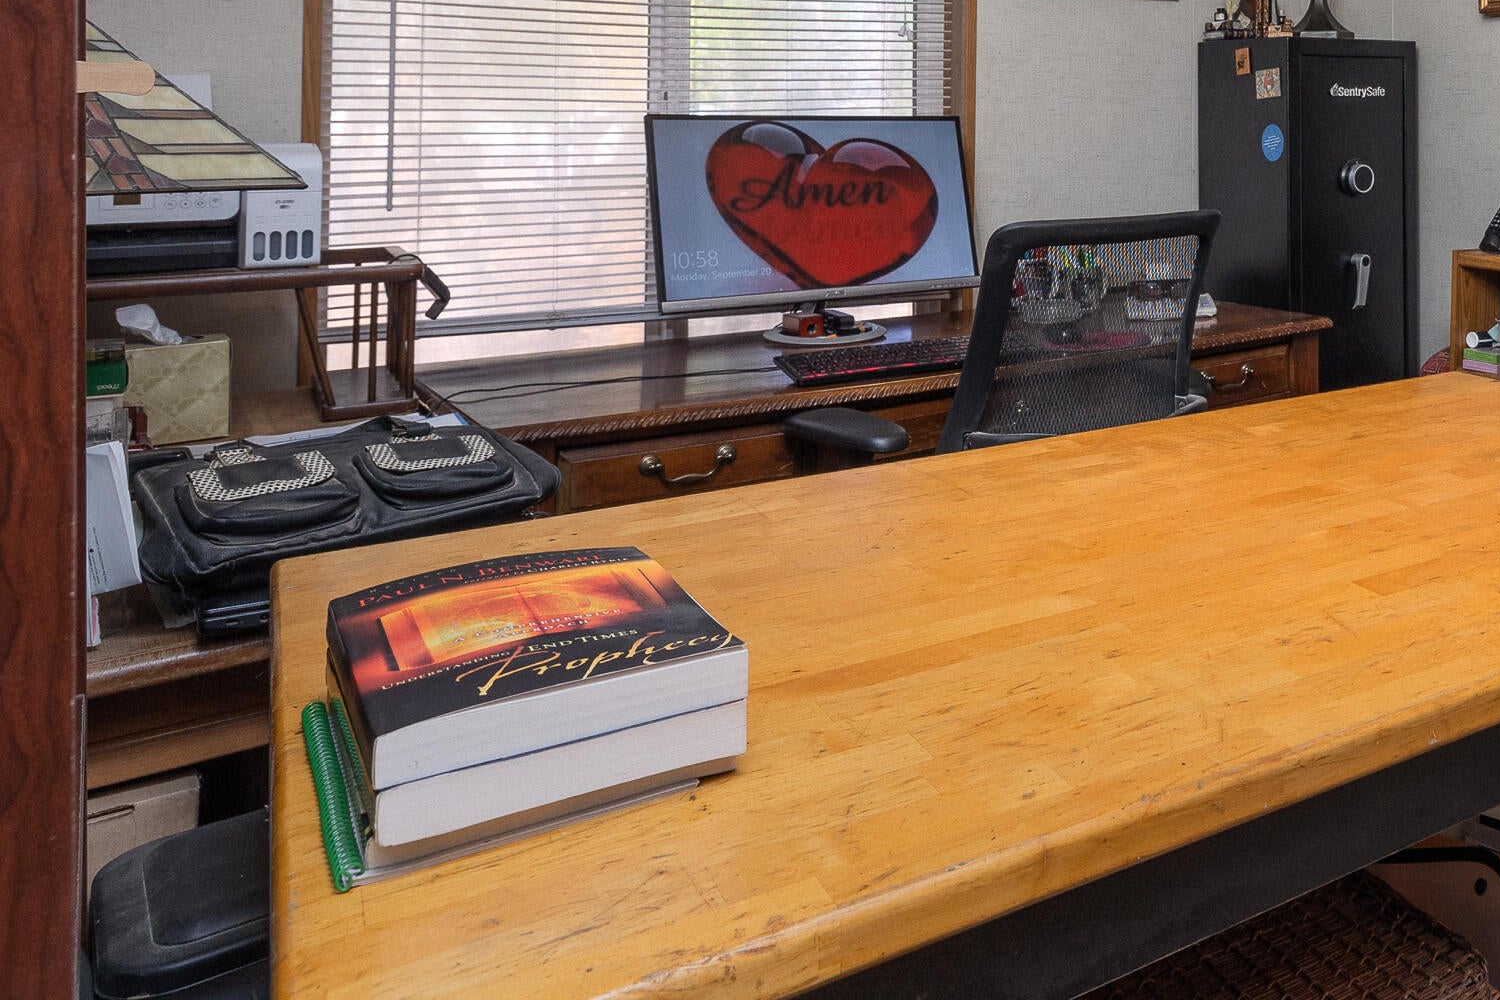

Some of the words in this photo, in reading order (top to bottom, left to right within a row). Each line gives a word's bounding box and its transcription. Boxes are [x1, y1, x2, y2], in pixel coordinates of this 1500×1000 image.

[1338, 86, 1386, 98] SentrySafe
[730, 153, 896, 212] Amen
[672, 250, 719, 270] 10:58
[670, 272, 709, 283] Monday,
[712, 268, 760, 281] September
[359, 583, 436, 608] PAUL
[475, 608, 622, 637] COMPREHENSIVE
[496, 619, 589, 640] APPROACH
[381, 651, 511, 690] UNDERSTANDING
[527, 640, 573, 652] END
[575, 629, 639, 644] TIMES
[456, 630, 733, 696] Prophecy
